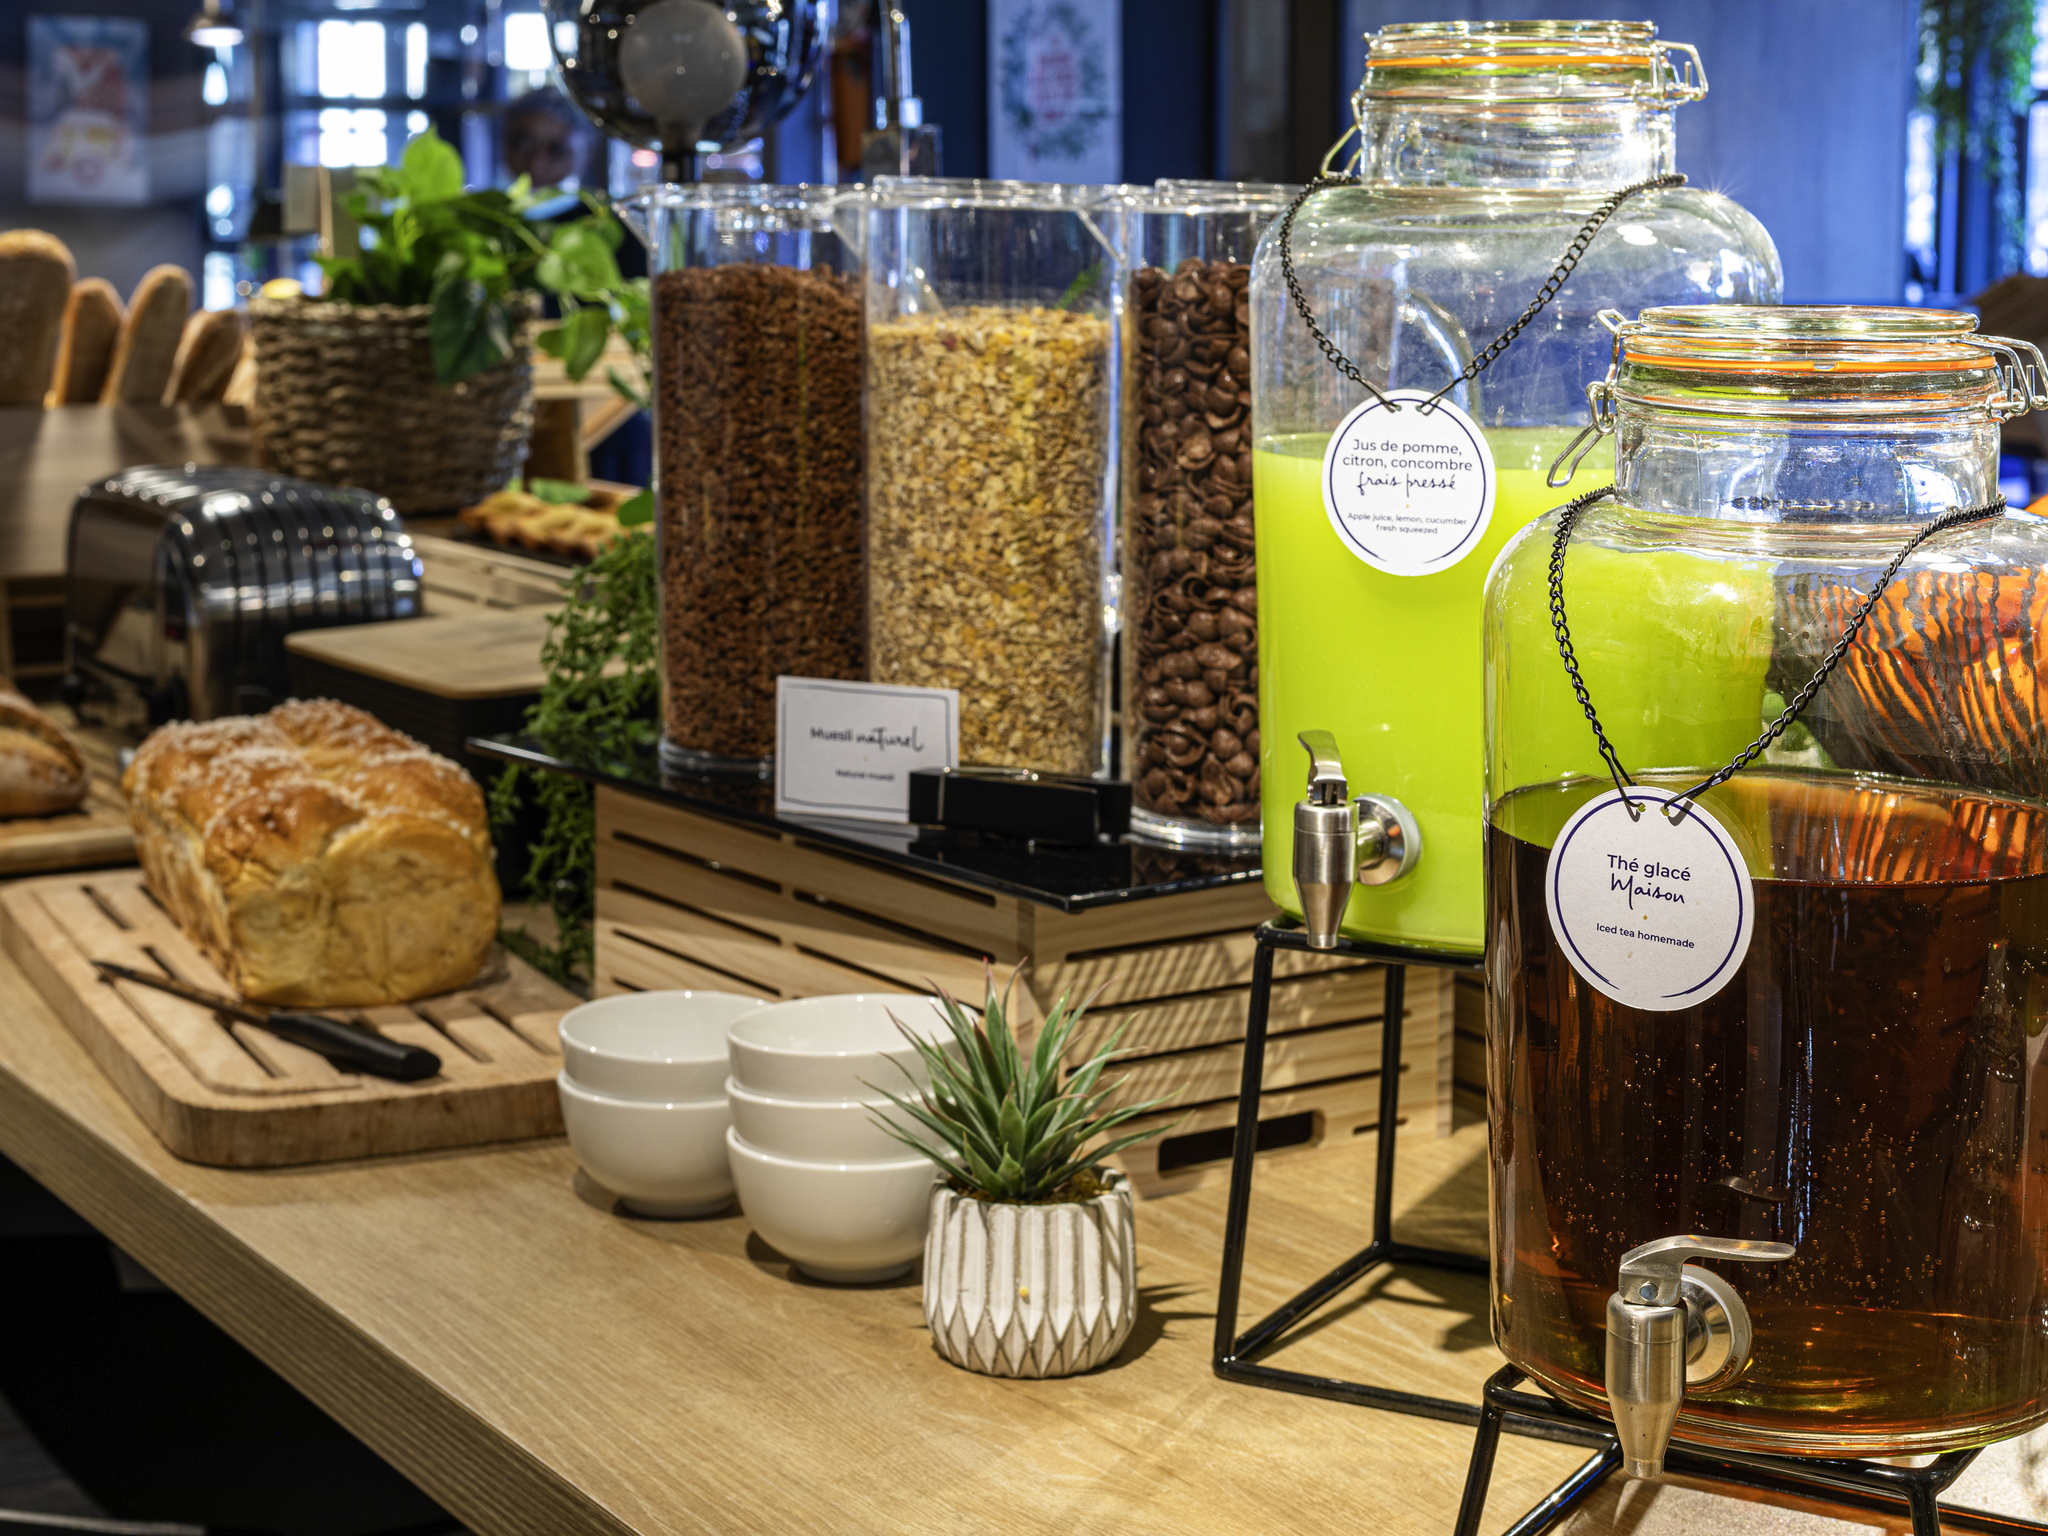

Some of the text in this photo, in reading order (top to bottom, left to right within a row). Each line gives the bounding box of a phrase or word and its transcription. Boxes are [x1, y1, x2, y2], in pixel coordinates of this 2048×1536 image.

[1353, 439, 1462, 456] Jus de pomme,
[1342, 454, 1473, 471] citron, concombre
[1357, 471, 1456, 498] frais pressé
[1347, 512, 1467, 526] Apple juice, lemon, cucumber
[1376, 524, 1438, 534] fresh squeezed
[856, 726, 924, 752] naturel
[1607, 854, 1690, 881] Thé glacé
[1611, 873, 1685, 910] Maison
[1596, 922, 1695, 948] Iced tea homemade
